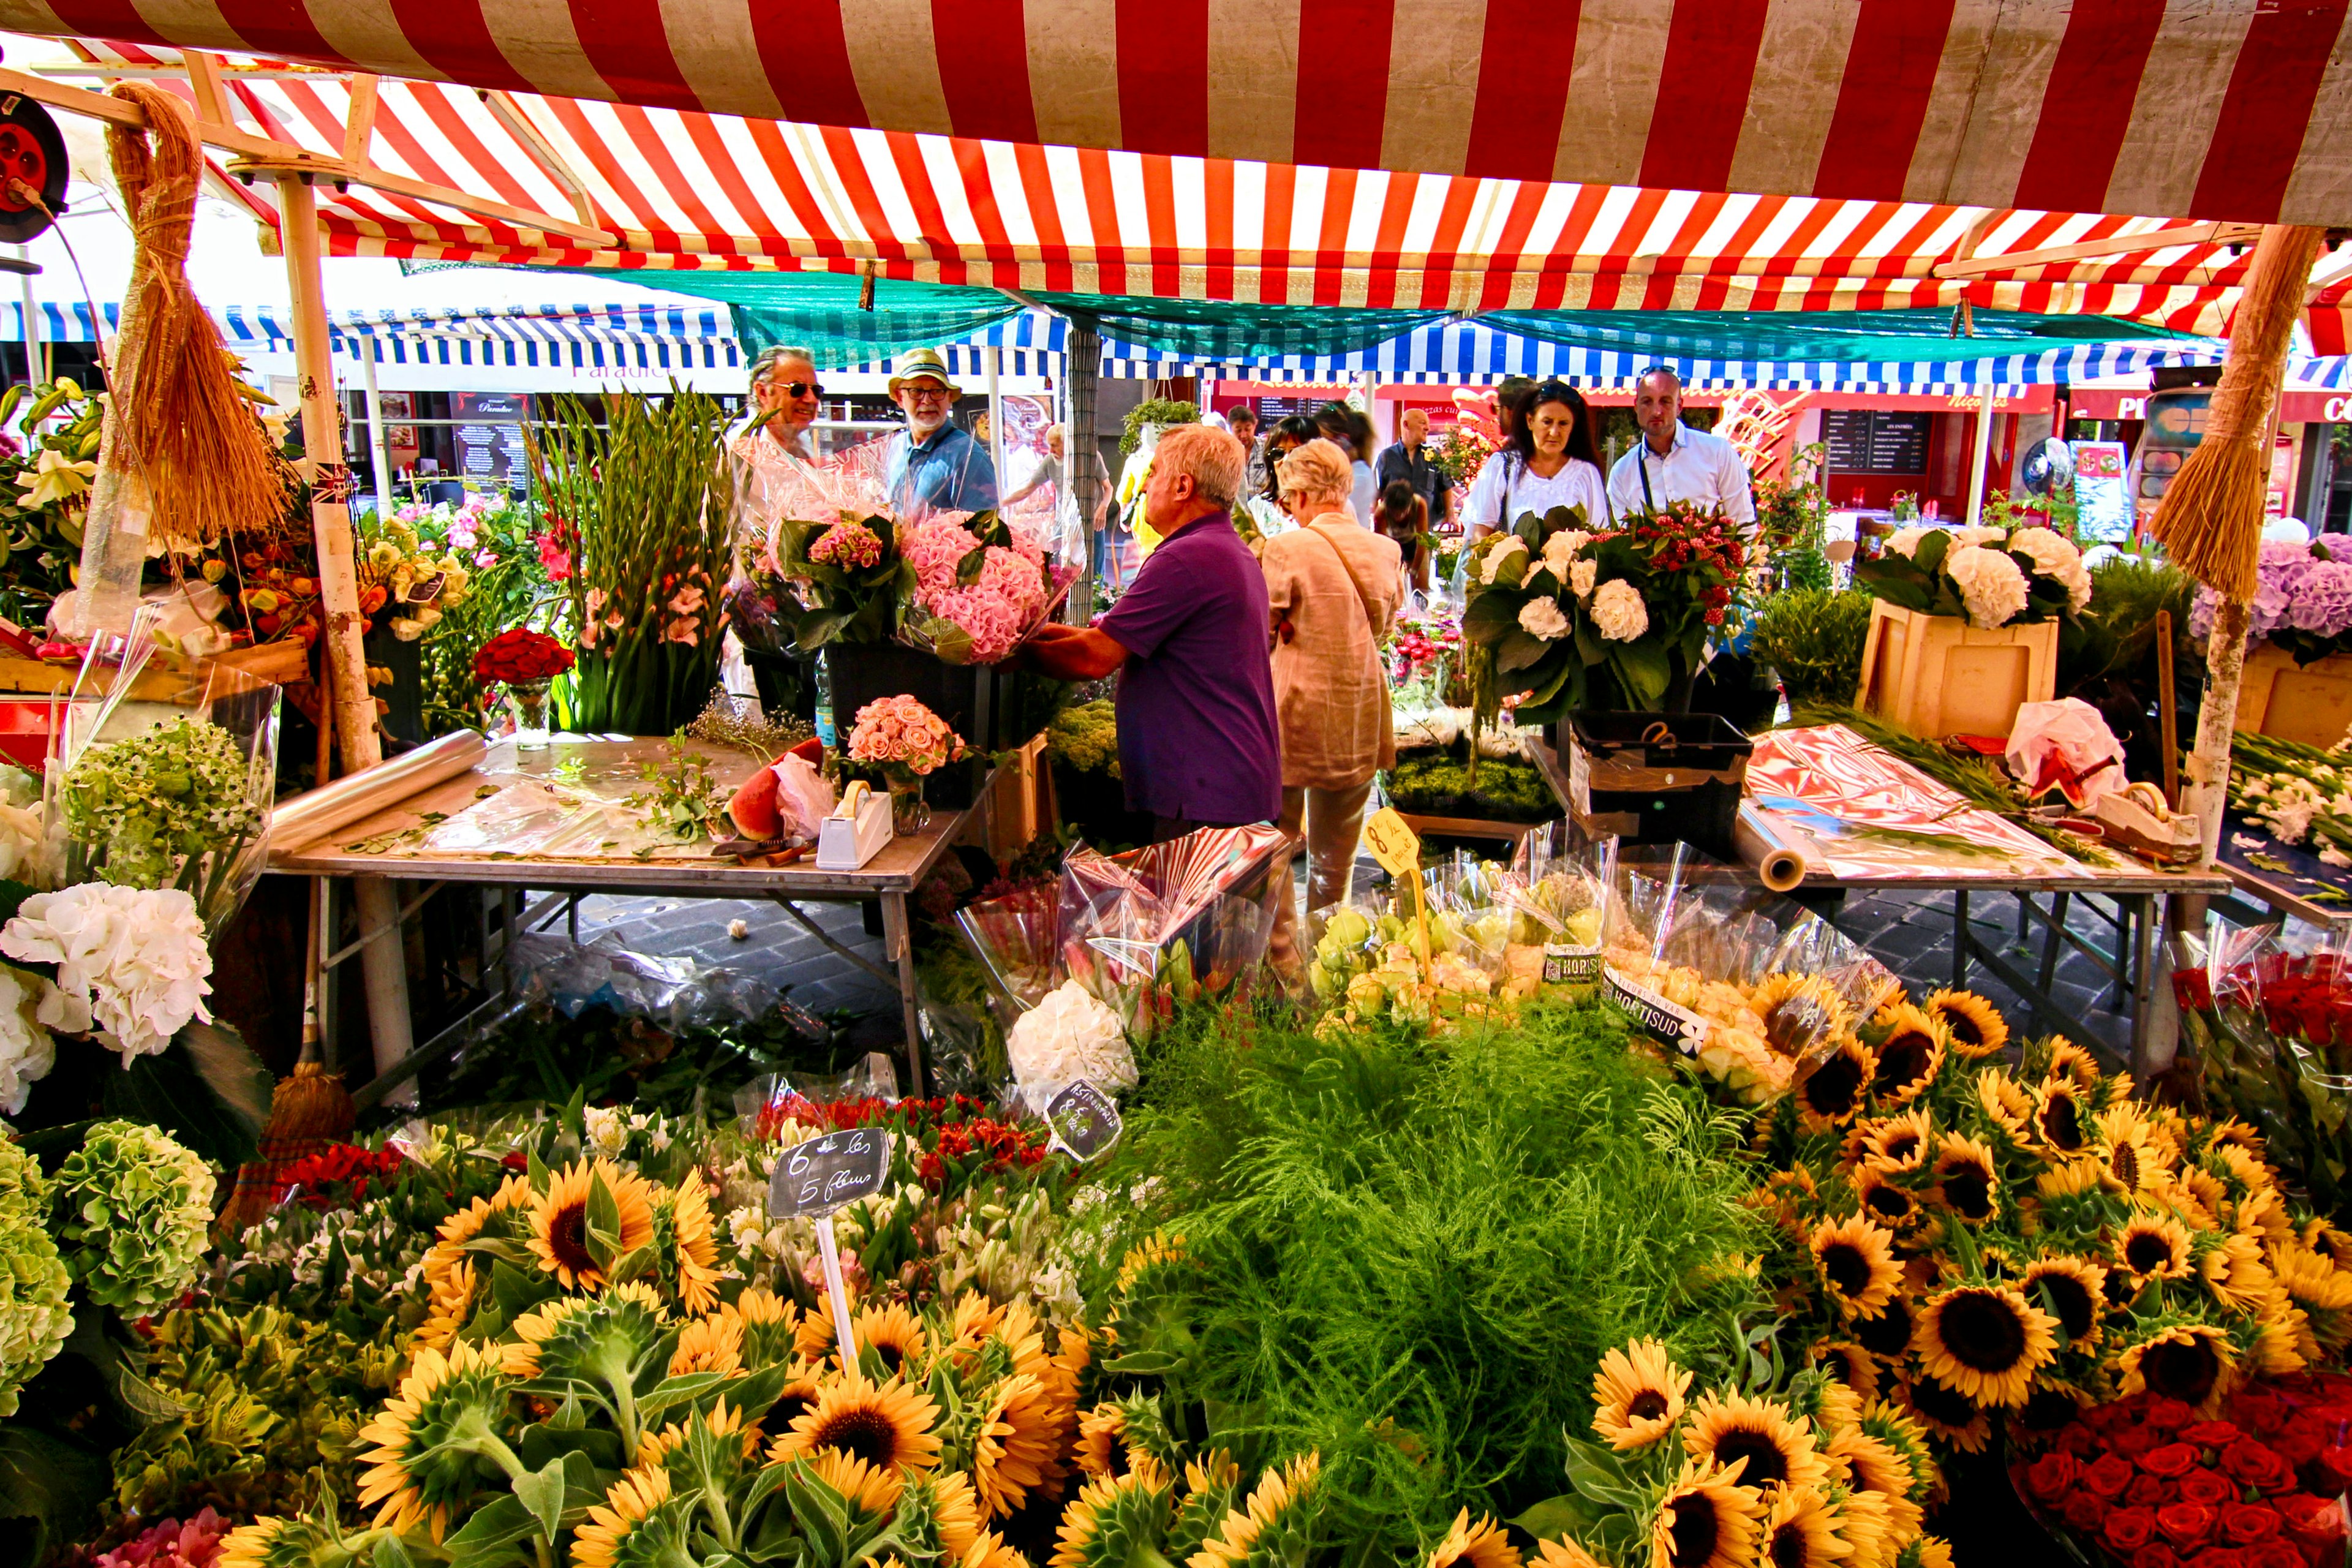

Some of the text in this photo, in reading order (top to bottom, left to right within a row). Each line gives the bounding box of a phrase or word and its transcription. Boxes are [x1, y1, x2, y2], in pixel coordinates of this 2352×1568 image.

[1367, 826, 1388, 854] 8
[1614, 990, 1678, 1036] HORTISUD
[1618, 978, 1680, 1016] FLEURS DU VAR
[789, 1144, 810, 1176] 6
[843, 1132, 871, 1154] les
[797, 1177, 821, 1204] 5
